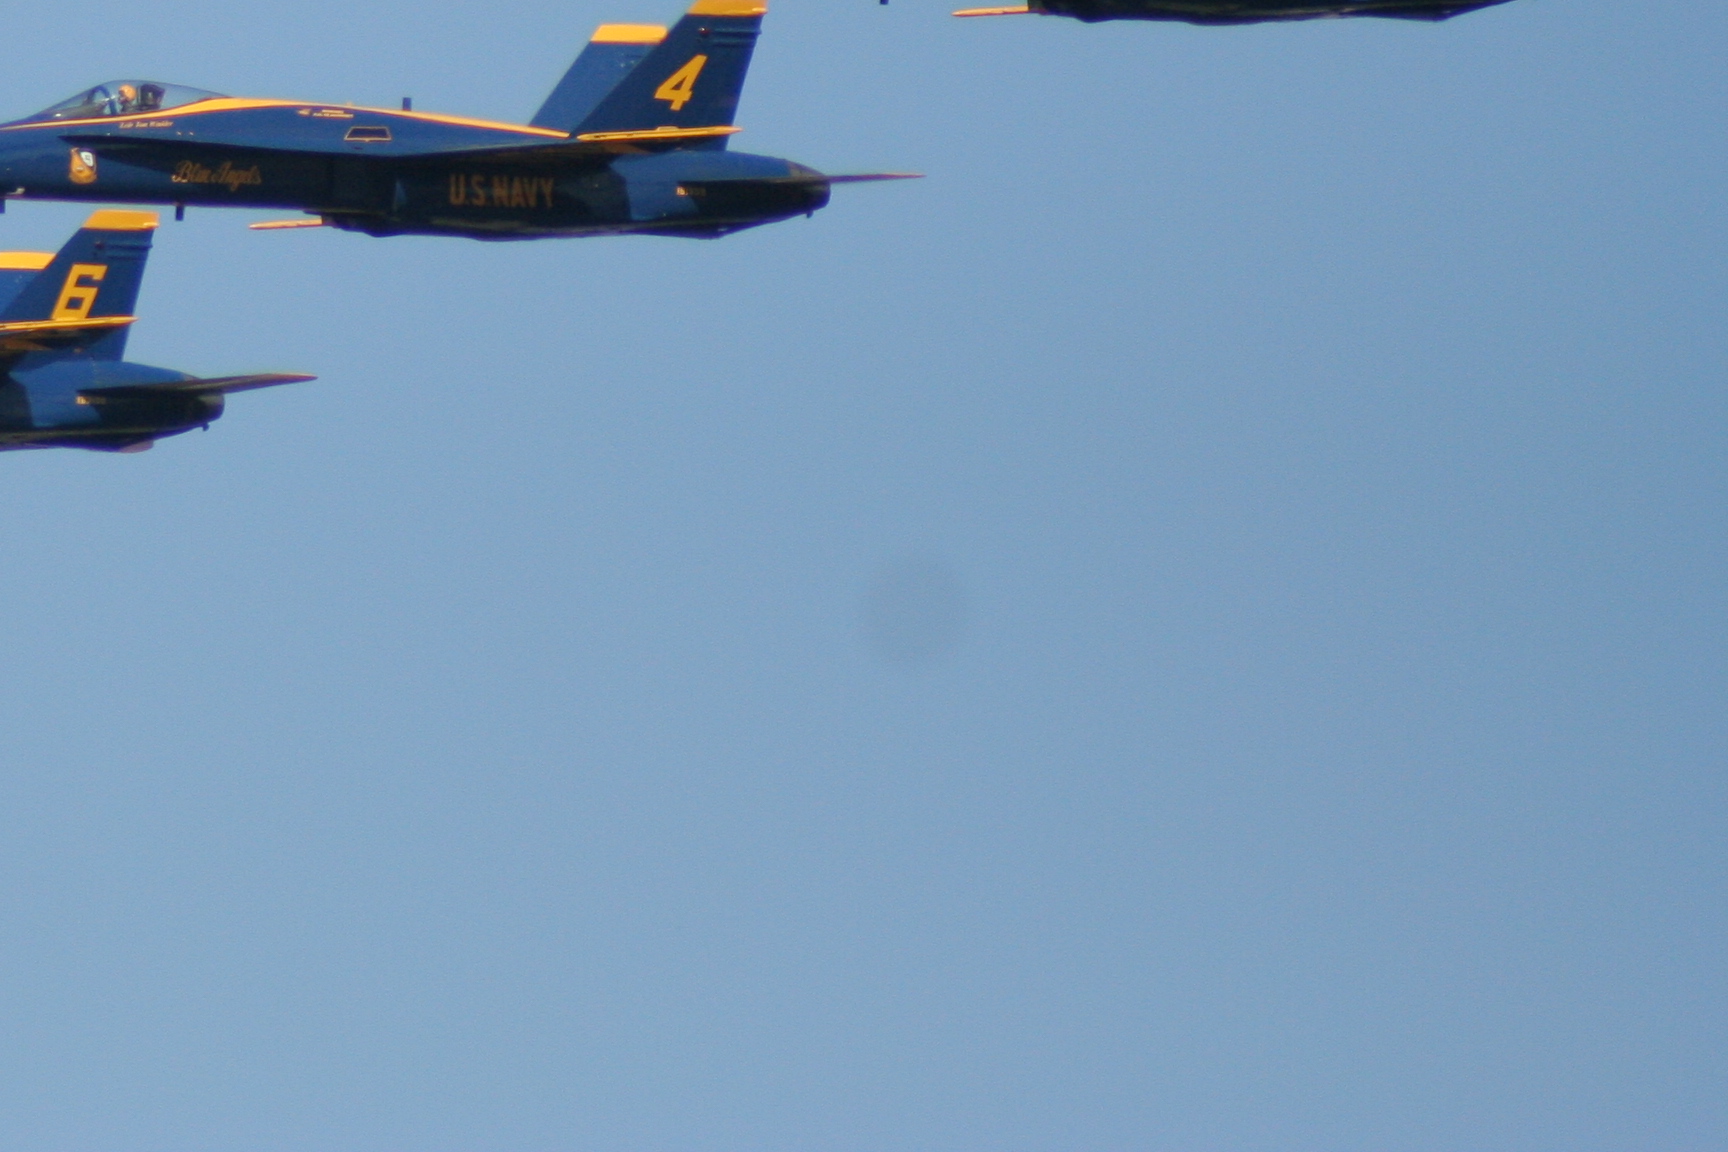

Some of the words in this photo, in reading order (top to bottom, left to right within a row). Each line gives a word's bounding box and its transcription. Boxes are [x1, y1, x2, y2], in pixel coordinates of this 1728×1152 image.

[654, 54, 707, 110] 4
[171, 160, 212, 183] Blue
[211, 161, 262, 192] Angels
[492, 175, 555, 209] NAVY
[51, 264, 108, 321] 6
